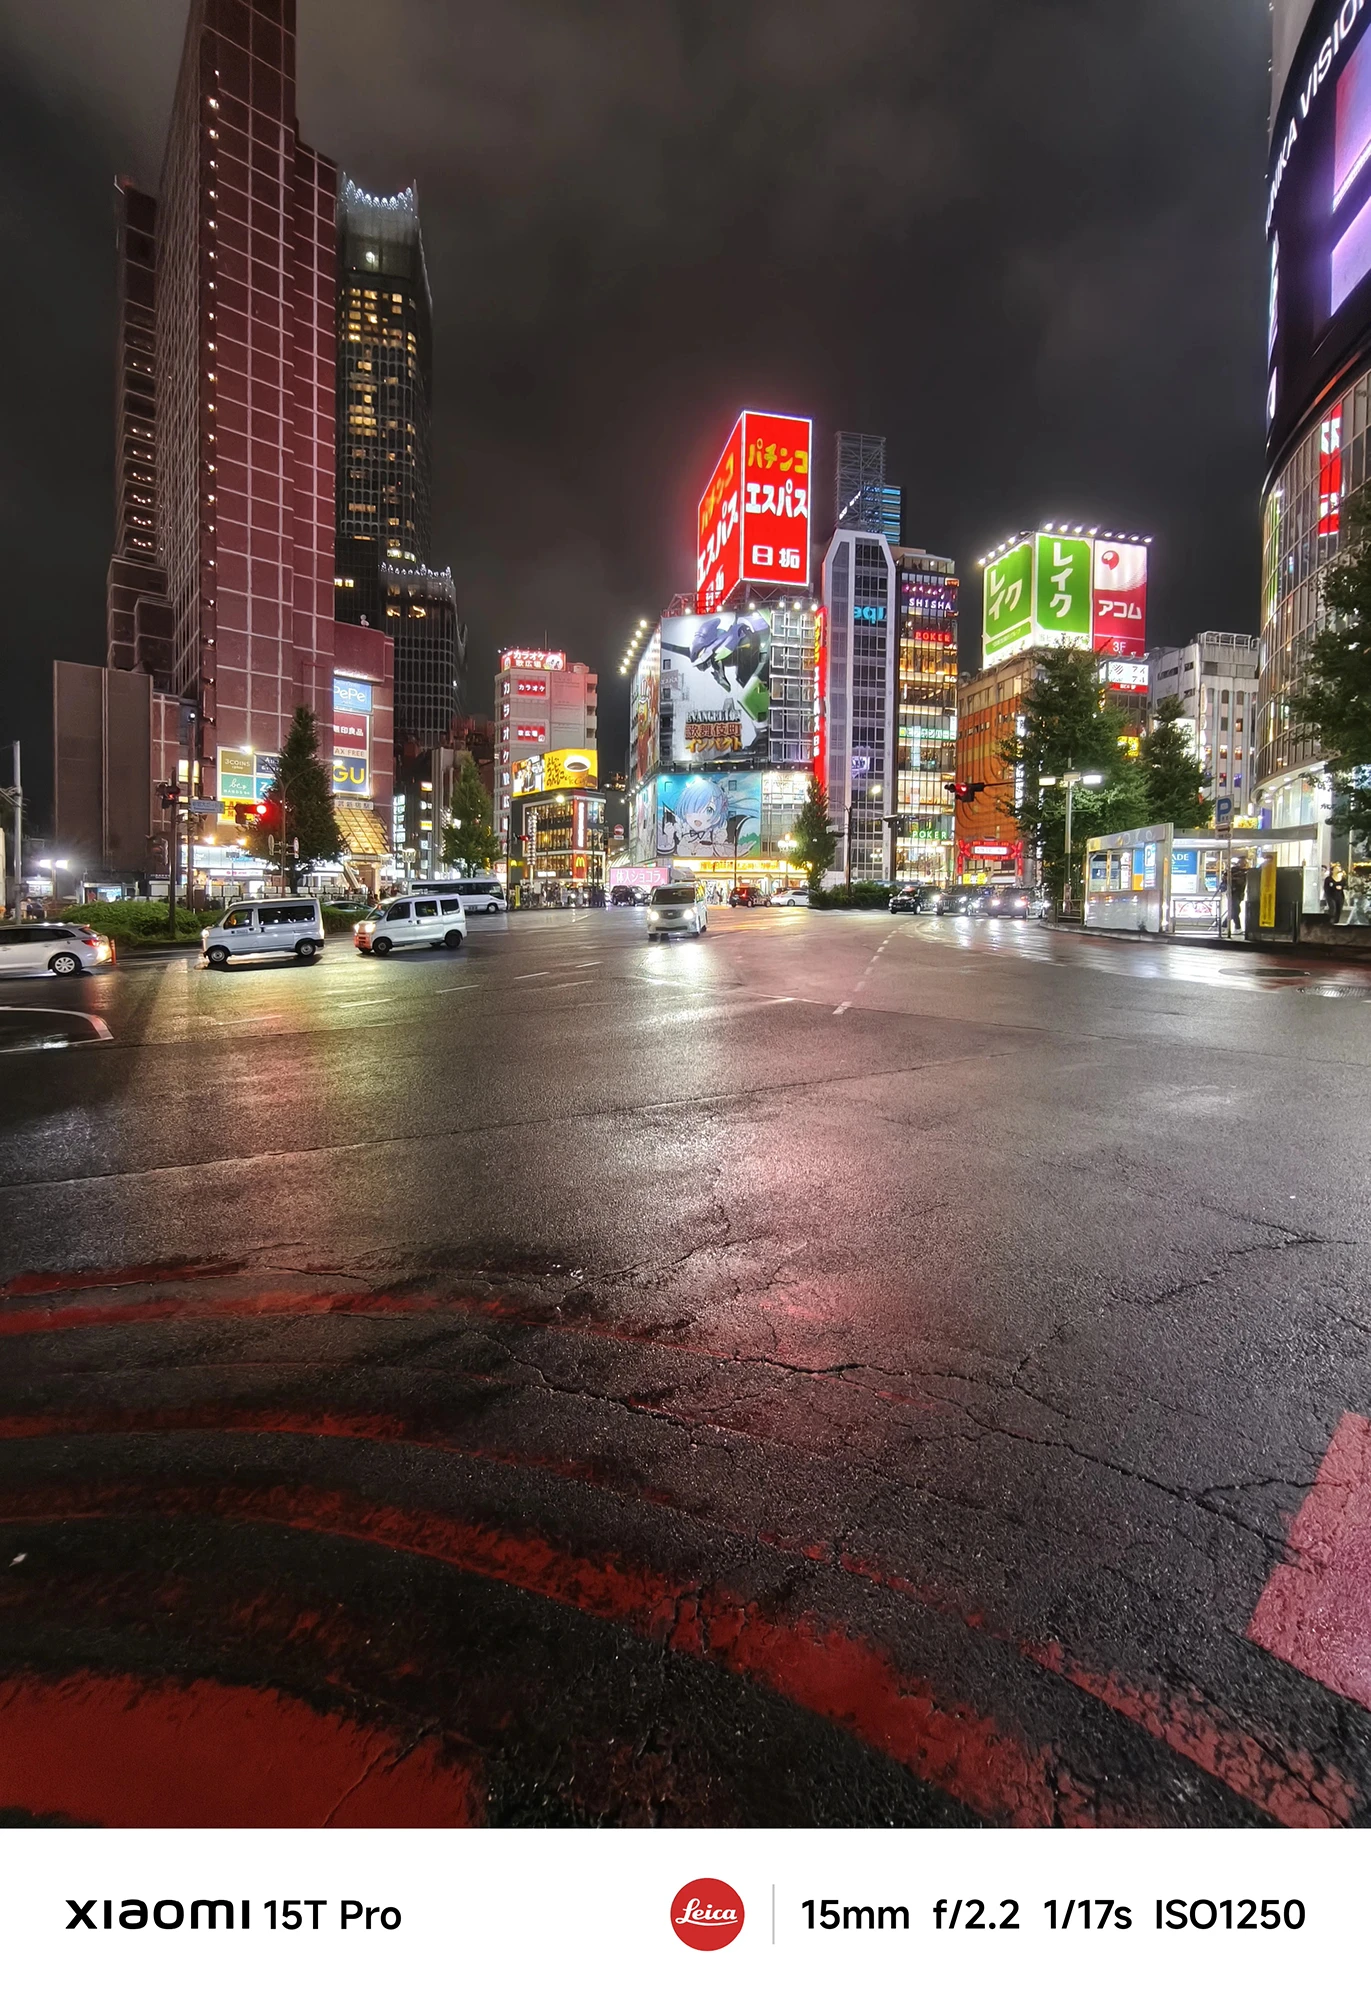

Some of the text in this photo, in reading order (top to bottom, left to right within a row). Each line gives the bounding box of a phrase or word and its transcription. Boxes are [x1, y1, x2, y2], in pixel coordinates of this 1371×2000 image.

[1300, 0, 1364, 118] VISIO
[747, 438, 808, 474] パチンコ
[745, 479, 807, 518] エスパス
[1050, 542, 1073, 618] レイク
[989, 570, 1022, 620] レイク
[909, 598, 951, 610] SHISHA
[1098, 600, 1142, 620] アコム
[915, 631, 950, 642] POKER
[1112, 641, 1126, 652] 3F
[513, 650, 546, 660] カラオケ
[519, 684, 545, 692] カラオケ
[685, 723, 742, 738] 歌舞伎町
[686, 738, 742, 753] インパクト
[333, 765, 365, 784] GU
[1217, 798, 1232, 821] P
[912, 830, 947, 840] POKER
[616, 870, 662, 882] 体入ショコラ
